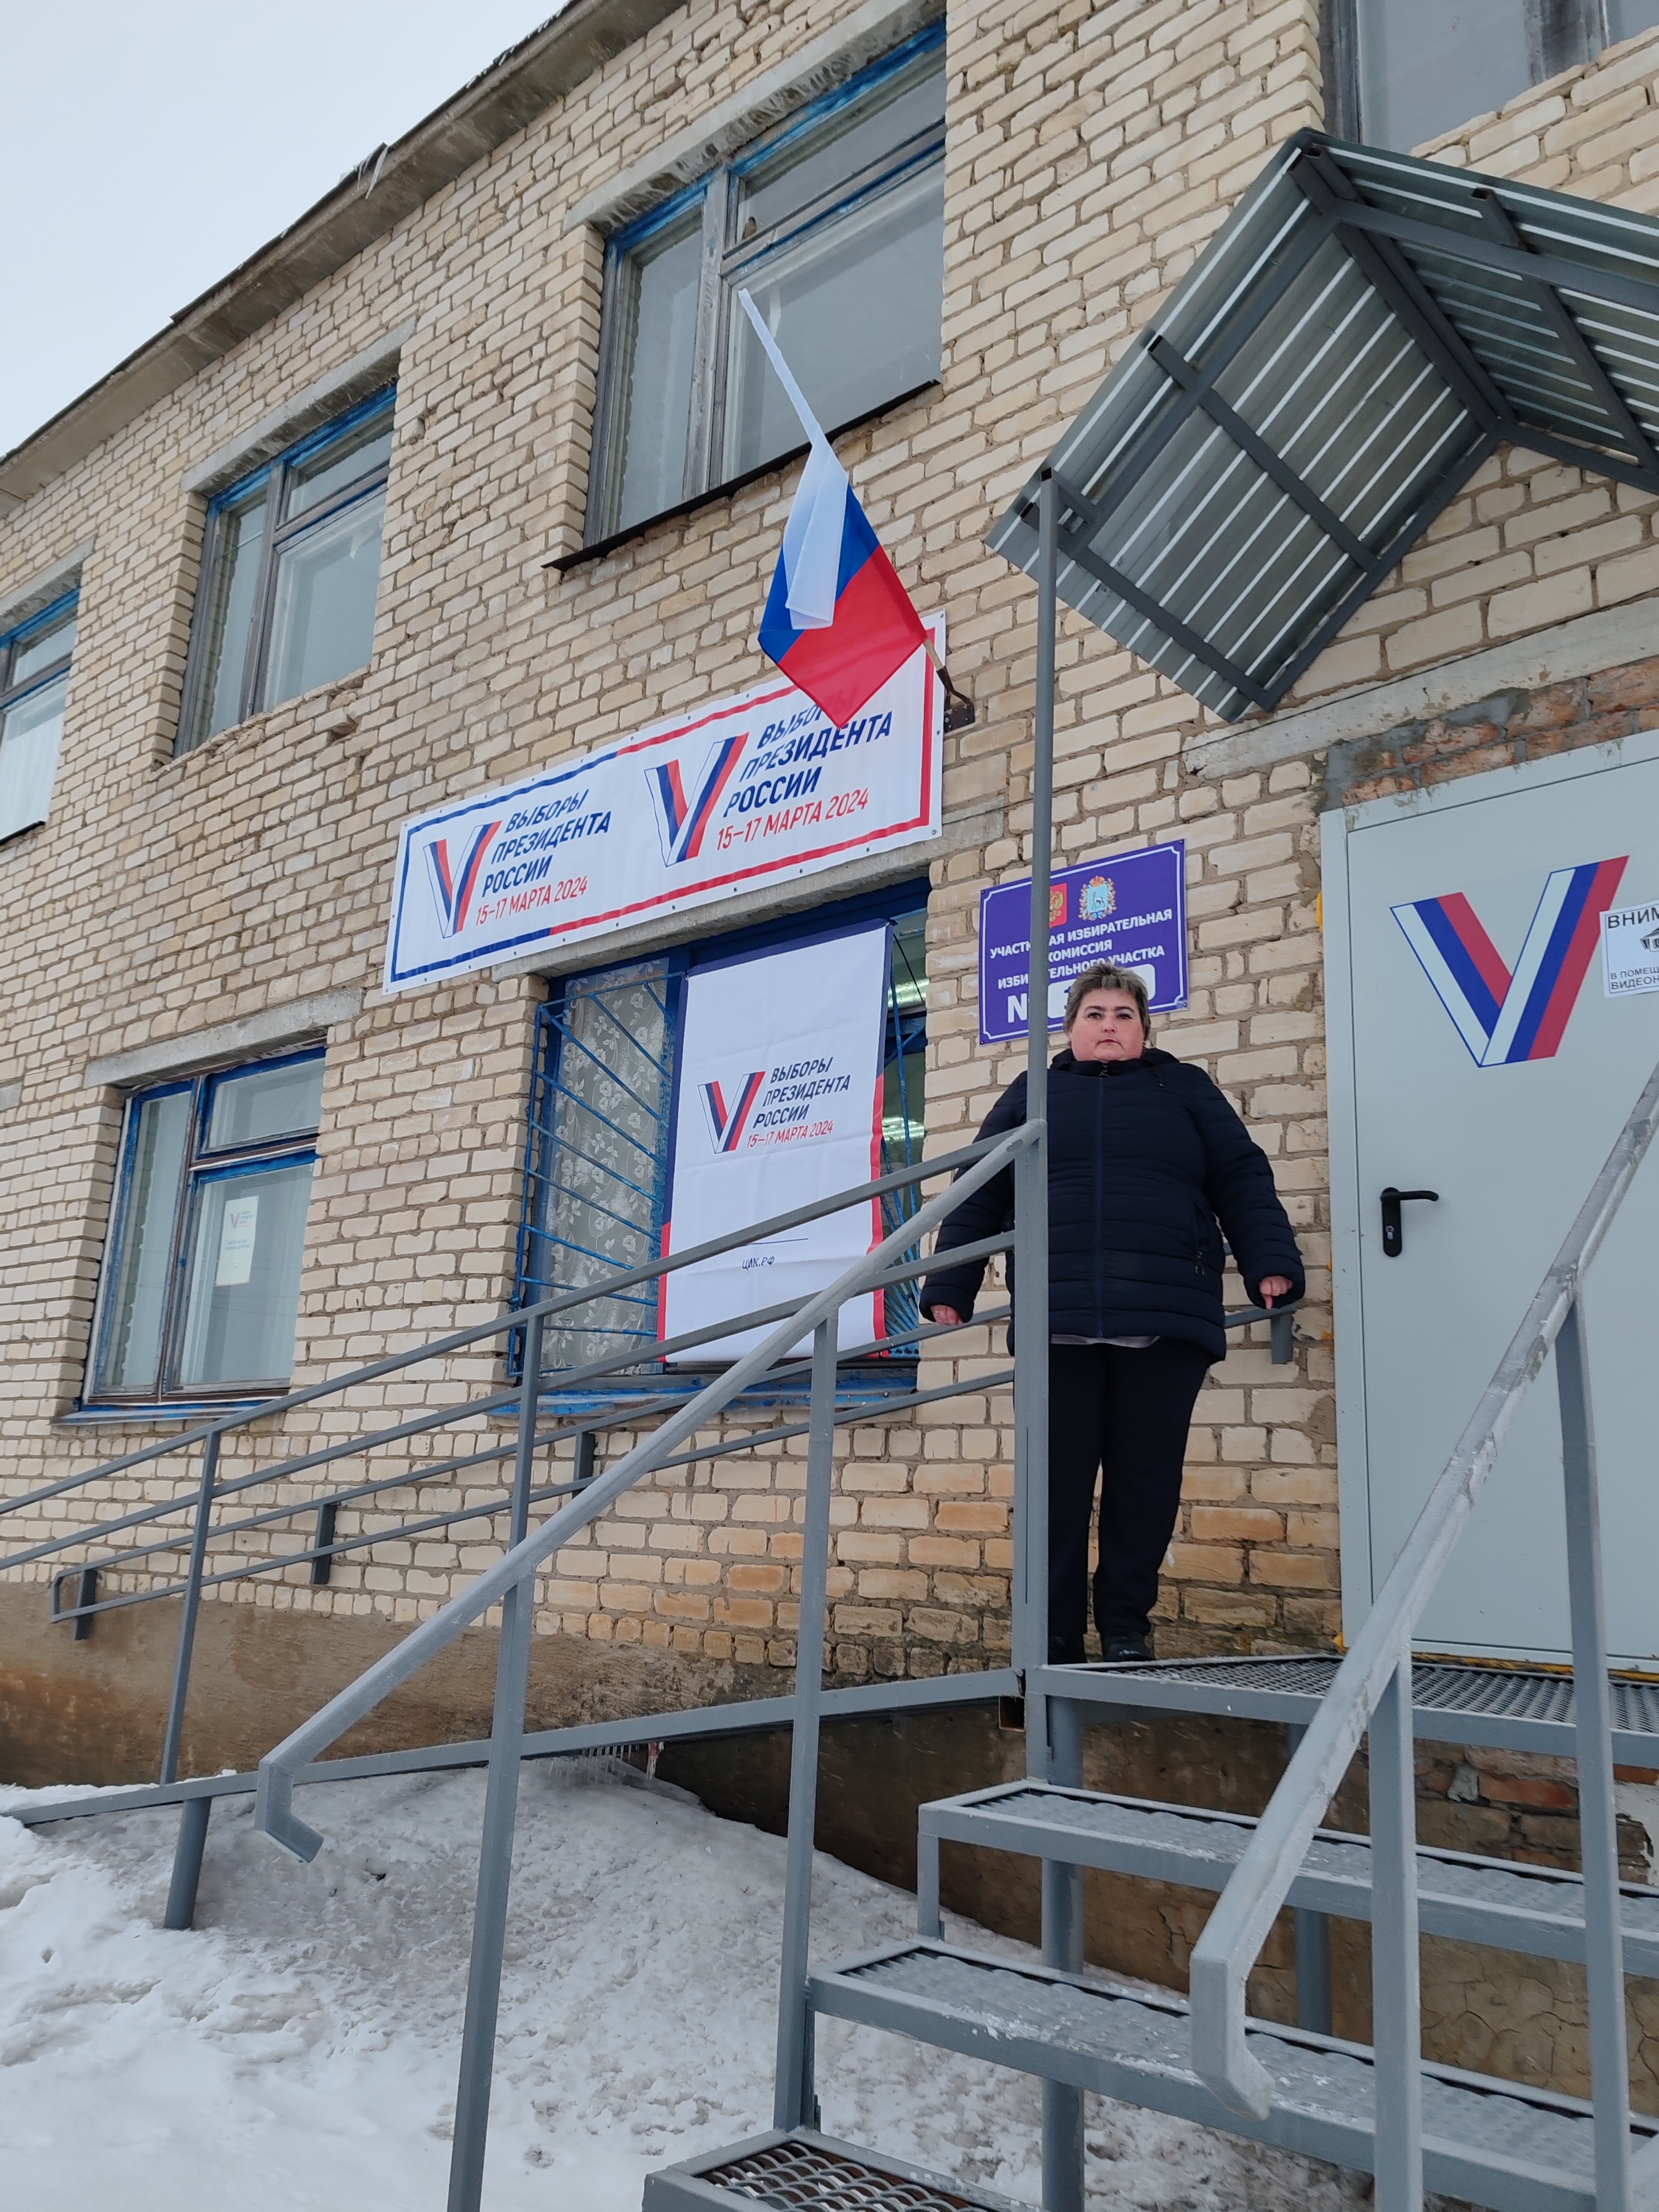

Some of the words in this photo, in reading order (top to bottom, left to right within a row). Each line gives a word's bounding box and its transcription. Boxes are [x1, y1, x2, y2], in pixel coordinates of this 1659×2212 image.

[739, 711, 893, 783] ПРЕЗИДЕНТА
[504, 789, 590, 834] ВЫБОРЫ
[723, 766, 822, 818] РОССИИ
[763, 800, 823, 838] МАРТА
[825, 788, 869, 820] 2024
[490, 811, 612, 865] ПРЕЗИДЕНТА
[482, 855, 553, 898] РОССИИ
[509, 884, 552, 916] МАРТА
[554, 875, 588, 904] 2024
[990, 933, 1065, 959] УЧАСТКАЯ
[1067, 908, 1173, 943] ИЗБИРАТЕЛЬНАЯ
[998, 957, 1106, 990] ИЗБИЕЛЬНОГ
[1108, 945, 1166, 966] УЧАСТКА
[1611, 975, 1659, 990] ВИДЕОН
[762, 1074, 851, 1107] ПРЕЗИДЕНТА
[770, 1056, 834, 1084] ВЫБОРЫ
[753, 1104, 810, 1128] РОССИИ
[775, 1125, 808, 1144] МАРТА
[809, 1120, 833, 1137] 2024
[742, 1256, 775, 1271] ЦИК.РФ
